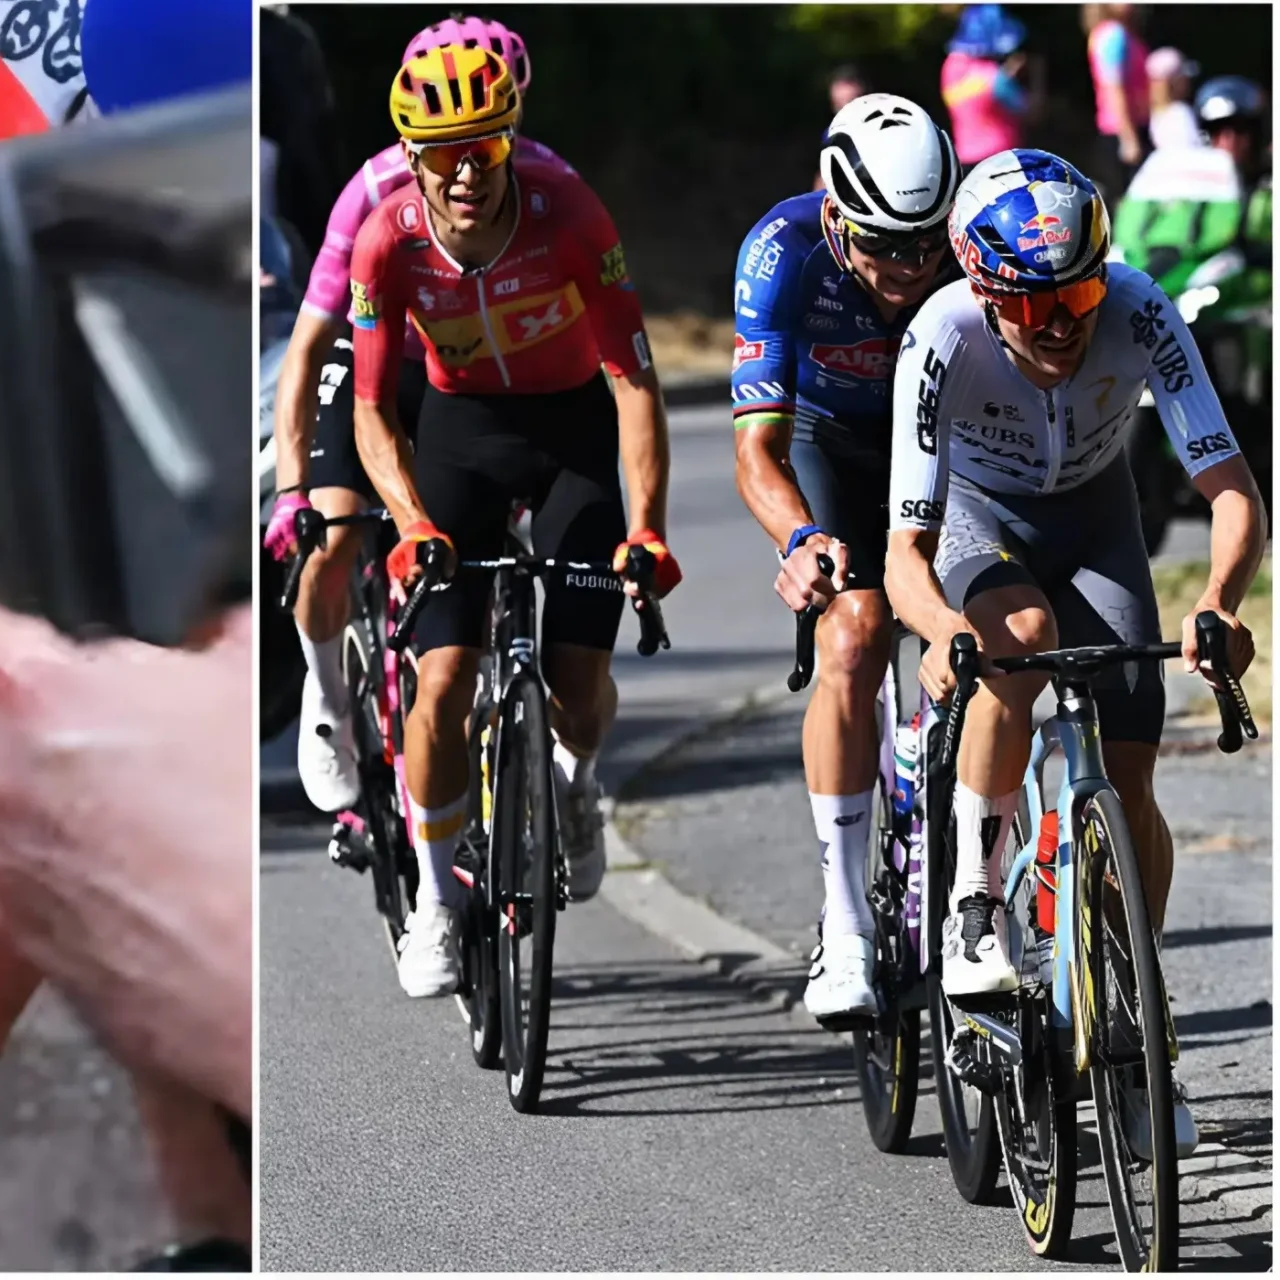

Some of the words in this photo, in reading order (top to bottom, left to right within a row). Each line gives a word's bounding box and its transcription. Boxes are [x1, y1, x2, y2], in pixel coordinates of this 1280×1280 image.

[743, 217, 789, 276] PREMIER
[756, 241, 785, 282] TECH
[1152, 331, 1194, 393] UBS
[980, 422, 1036, 449] UBS
[1187, 432, 1232, 460] SGS
[900, 498, 945, 522] SGS
